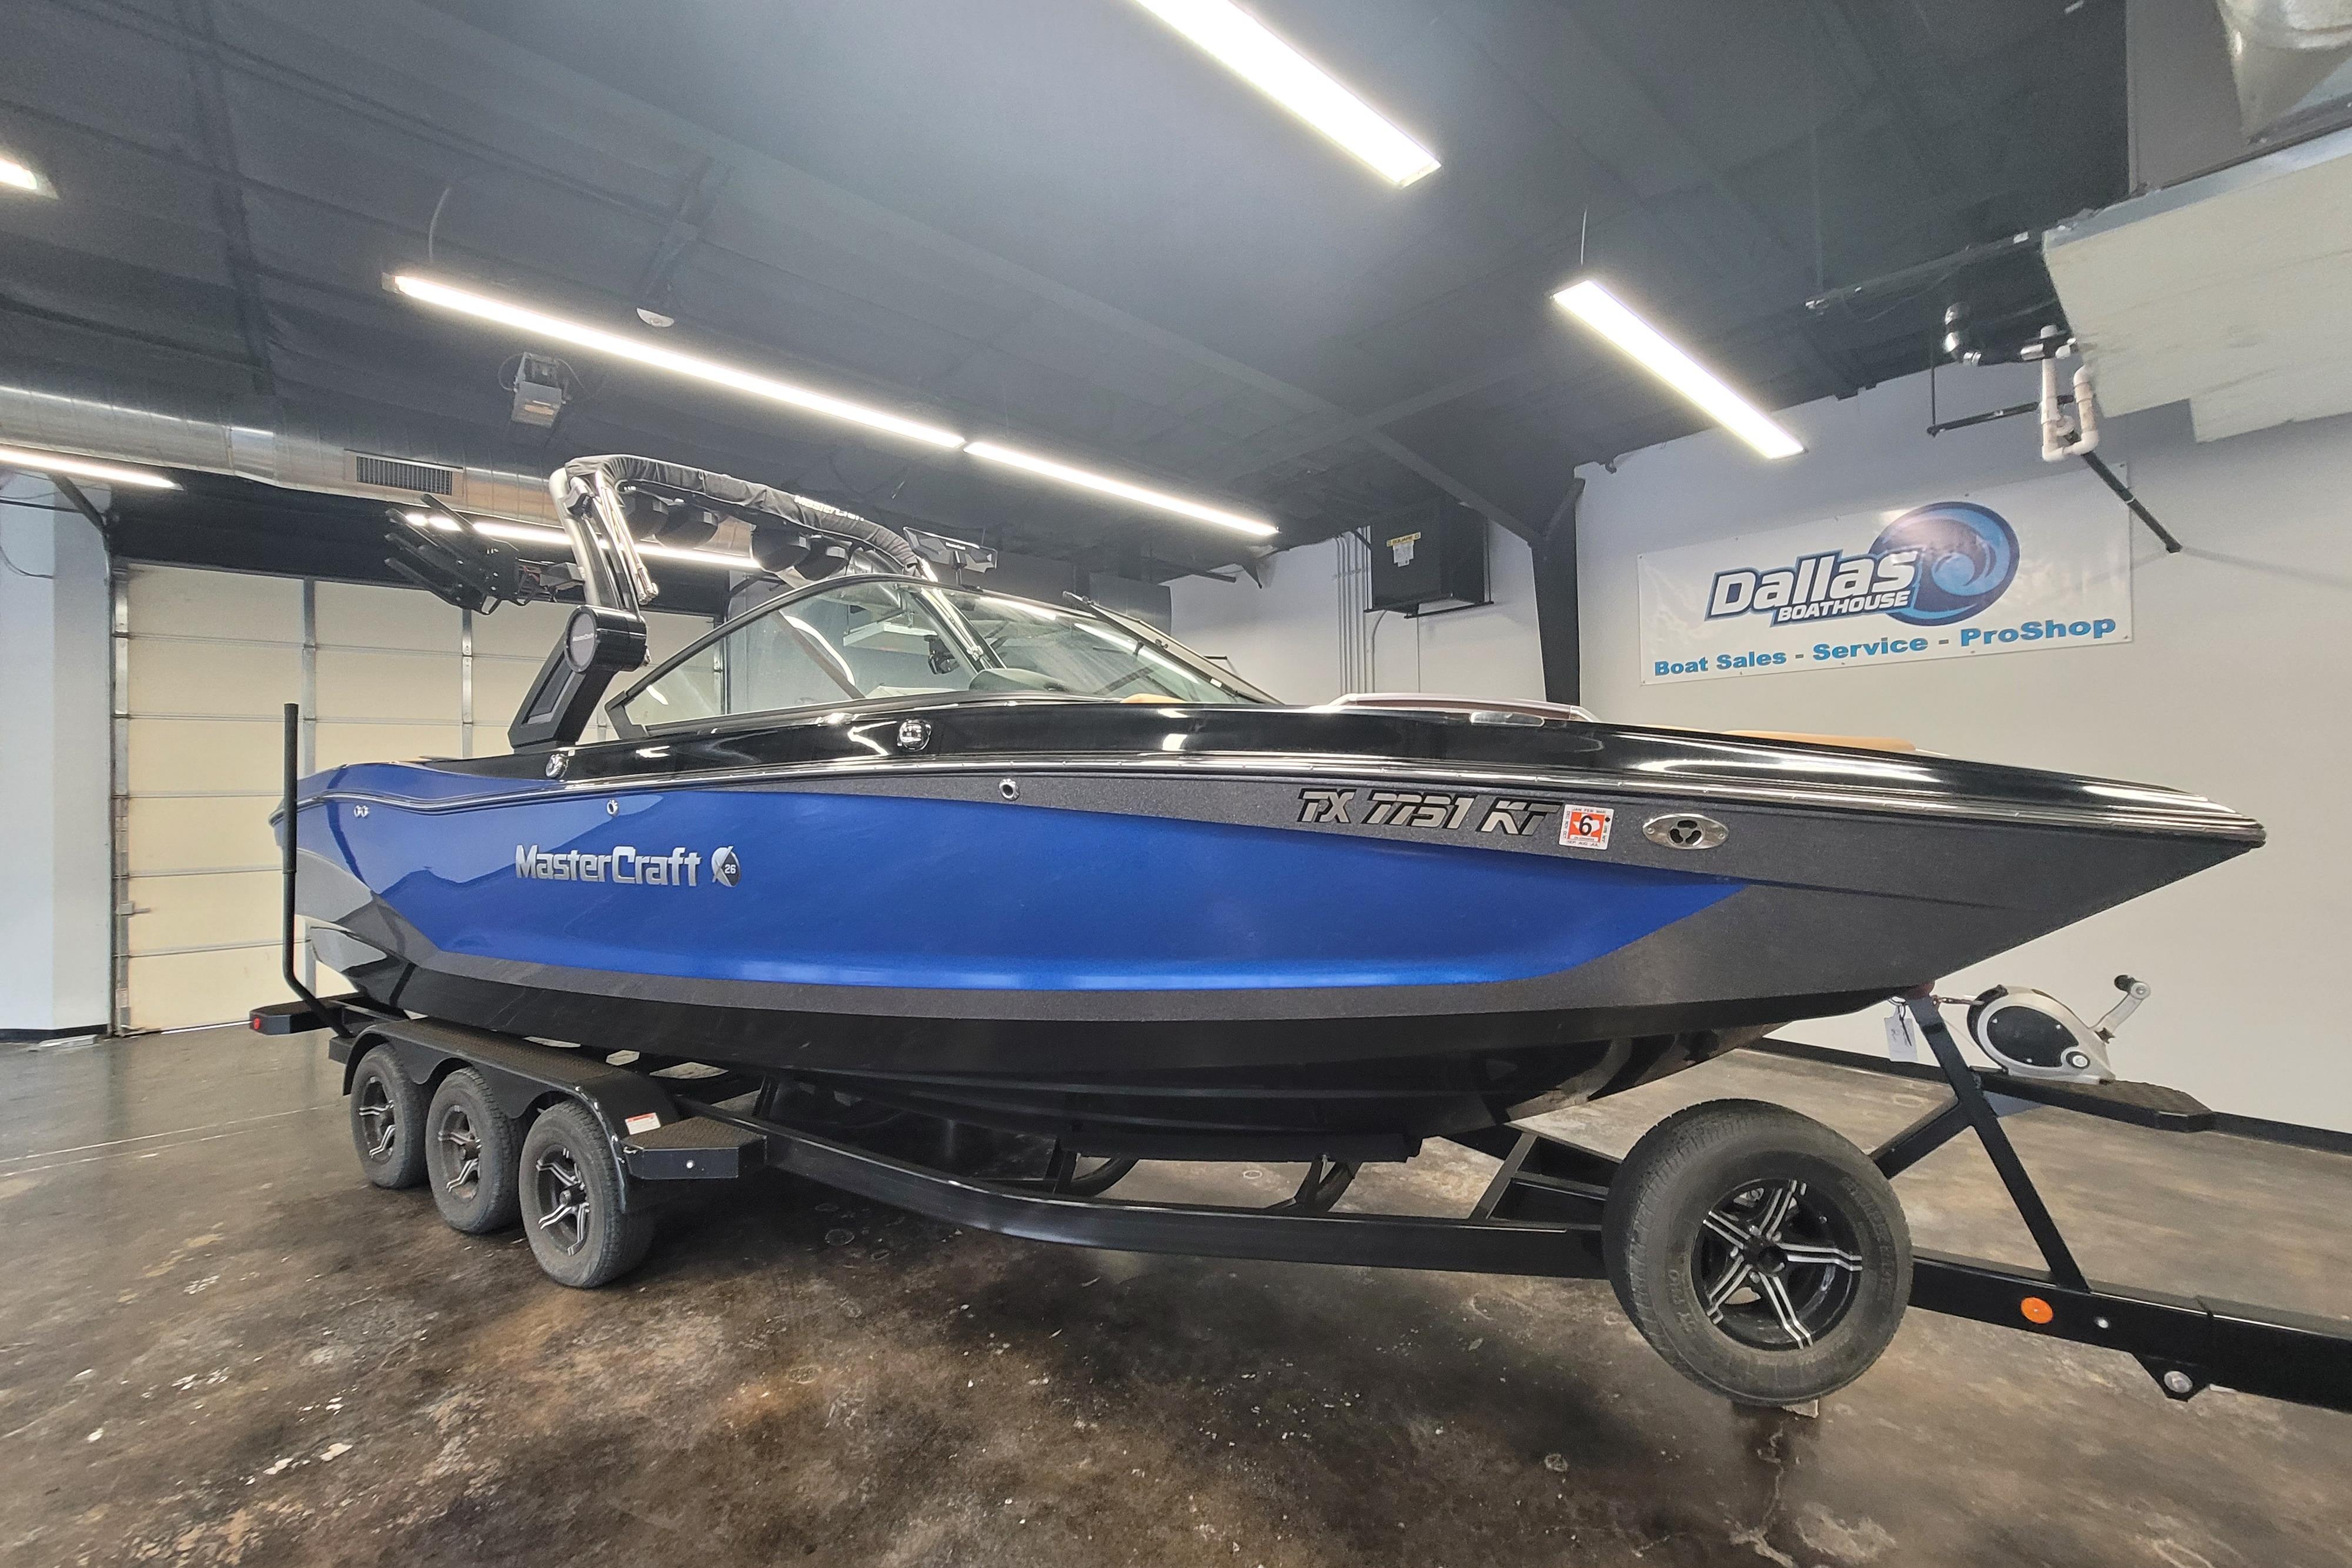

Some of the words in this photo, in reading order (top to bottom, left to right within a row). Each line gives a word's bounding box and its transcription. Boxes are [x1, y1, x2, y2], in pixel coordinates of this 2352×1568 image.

[1709, 549, 1919, 617] Dallas
[1777, 590, 1912, 622] BOATHOUSE
[1655, 657, 1709, 676] Boat
[1716, 651, 1786, 670] Sales
[1813, 637, 1929, 661] Service
[1960, 618, 2116, 647] ProShop
[1298, 788, 1356, 823] TX
[1476, 797, 1564, 836] KT
[1579, 815, 1592, 835] 6
[515, 844, 703, 887] MasterCraft
[724, 863, 737, 875] 26
